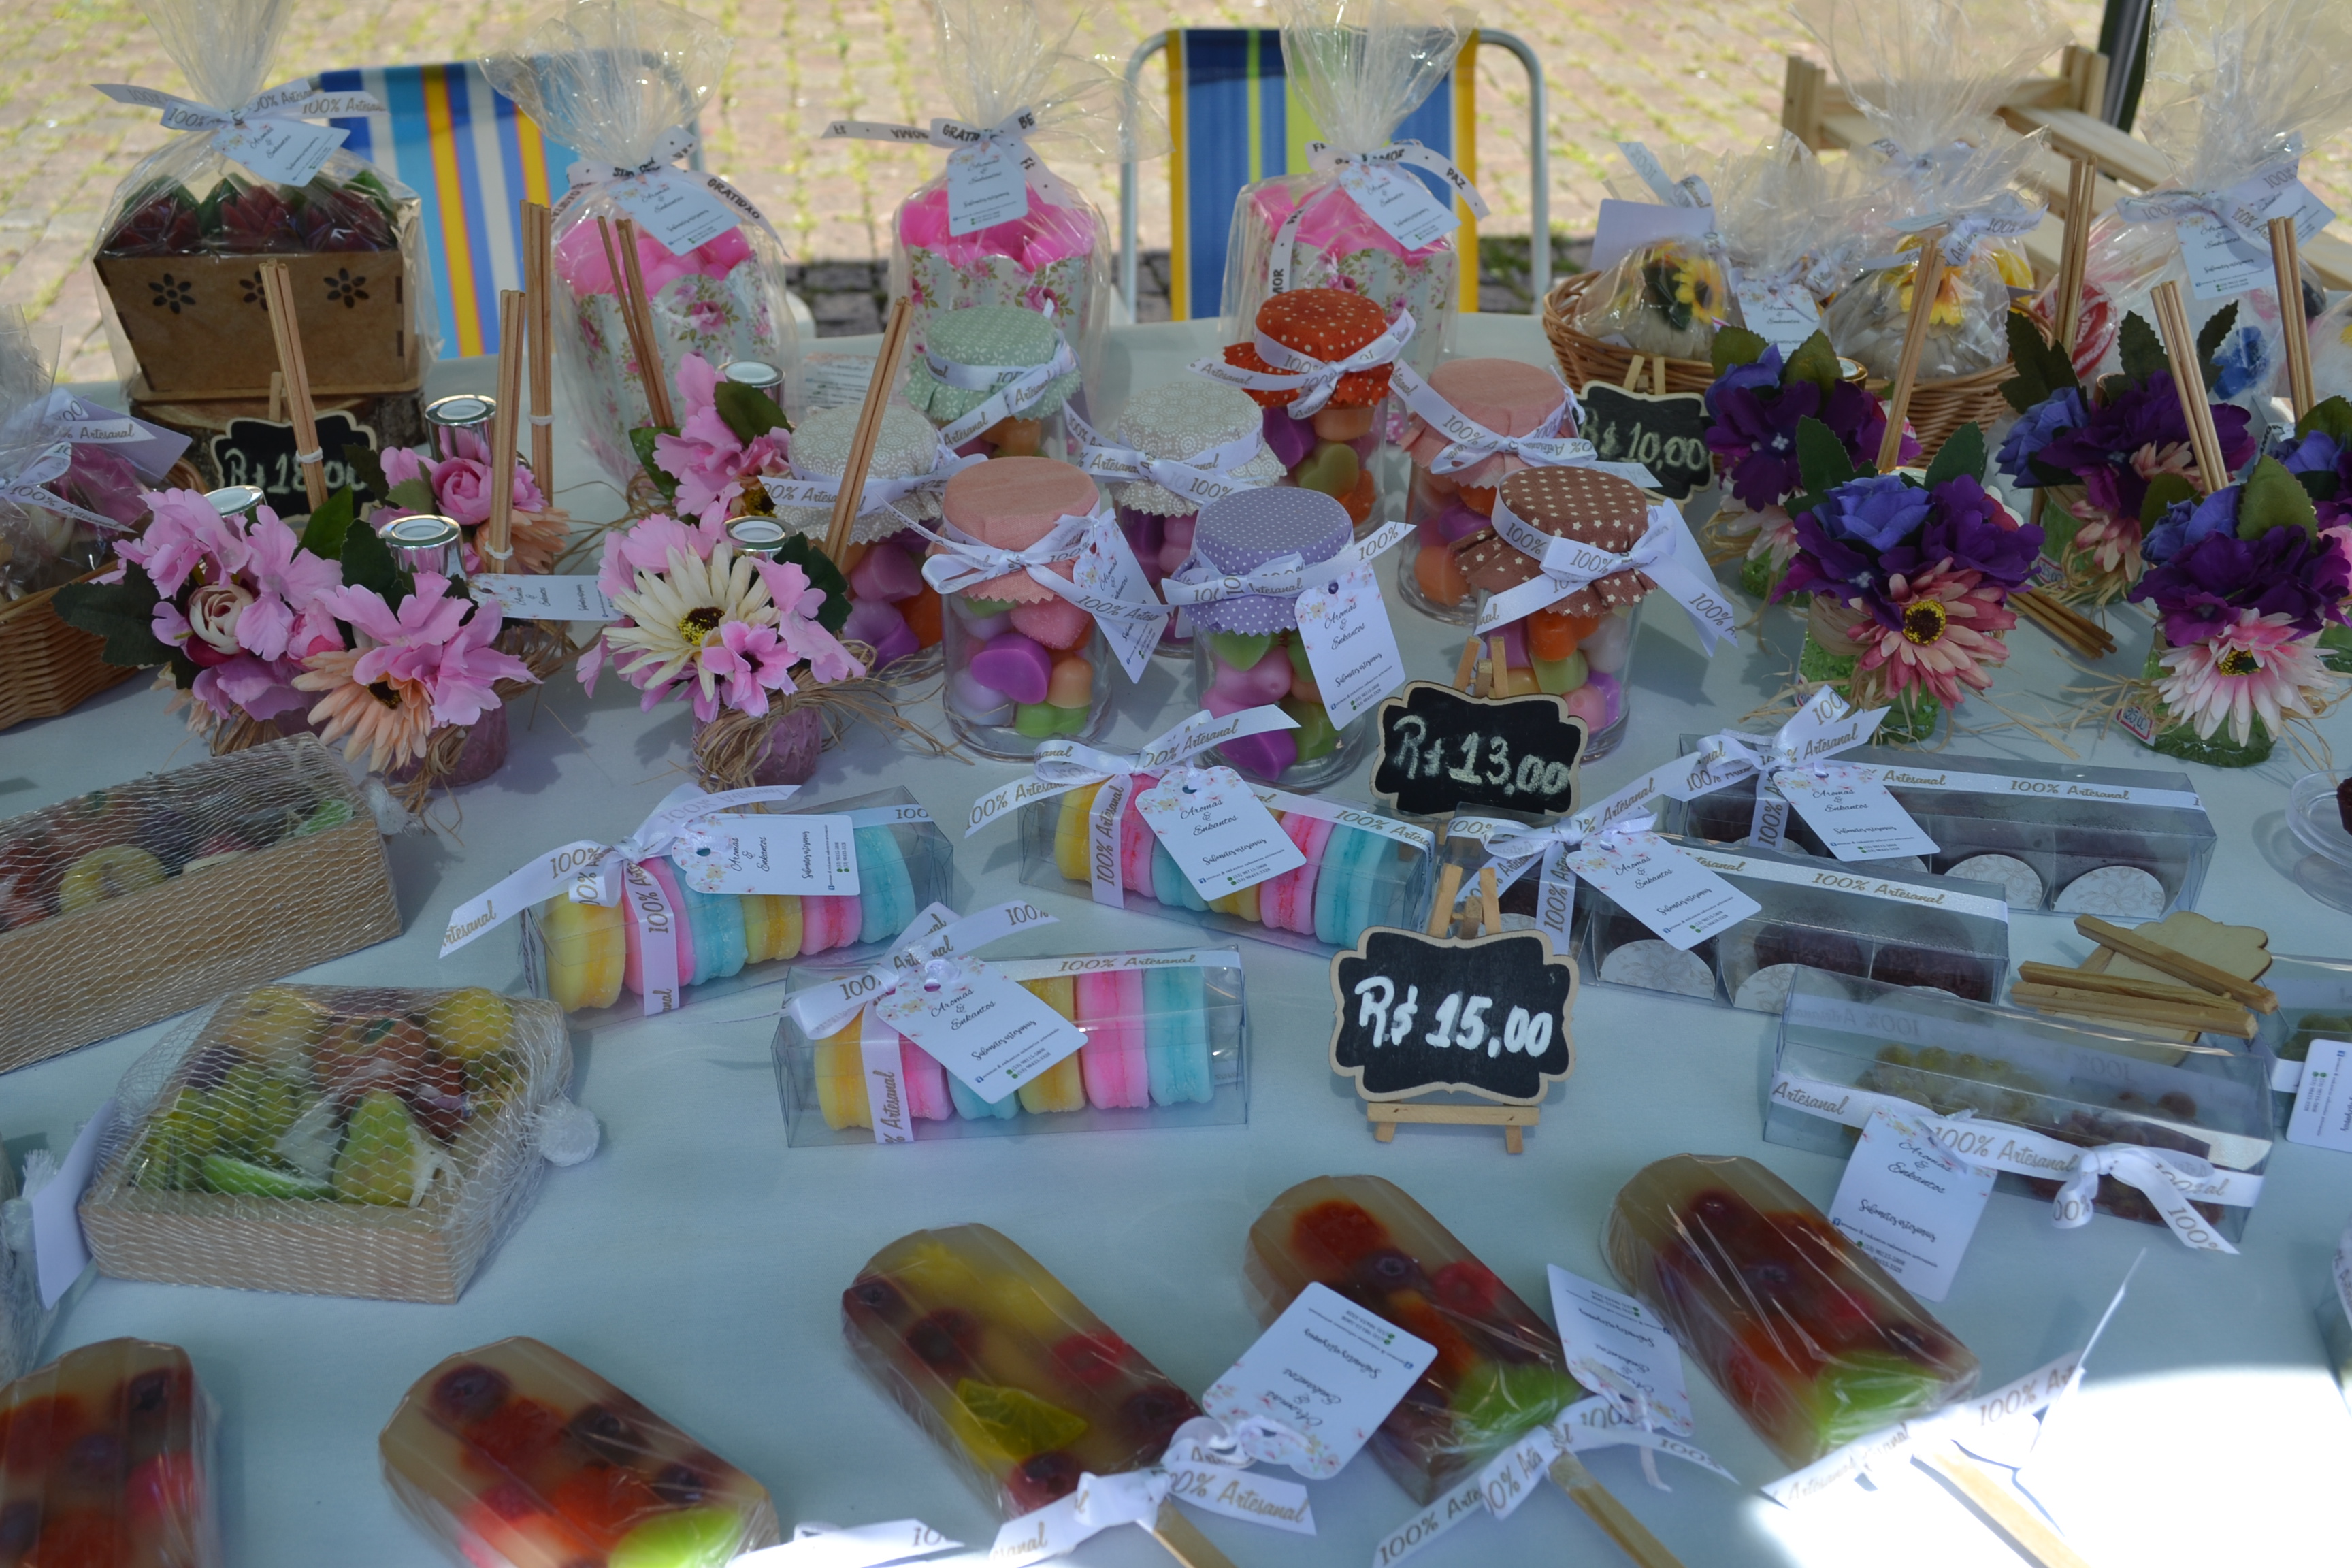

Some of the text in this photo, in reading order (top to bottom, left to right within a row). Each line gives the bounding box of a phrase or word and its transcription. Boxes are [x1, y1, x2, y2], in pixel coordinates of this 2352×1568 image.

[1446, 167, 1466, 190] PAZ
[1015, 370, 1051, 406] Artesanal
[1200, 362, 1254, 385] Artesanal
[80, 423, 134, 440] Artesanal
[944, 411, 989, 445] Artesanal
[1441, 414, 1486, 446] 100%
[1621, 422, 1710, 471] 10,00
[10, 485, 60, 507] 100%
[1358, 525, 1400, 562] 100%
[1506, 522, 1548, 555] 100%
[1569, 549, 1614, 575] 100%
[1075, 595, 1126, 616] 100%
[1324, 602, 1357, 630] Aromas
[1688, 593, 1733, 627] 100%
[1331, 622, 1366, 650] Enkantos
[1181, 718, 1239, 754] Artesanal
[1803, 723, 1858, 760] Artesanal
[1448, 732, 1571, 796] 13,00
[1601, 777, 1656, 826] Artesanal
[1812, 789, 1855, 798] Aromas
[1882, 770, 2131, 802] Artesanal 100% Artesanal
[1179, 799, 1224, 819] Aromas
[1202, 811, 1212, 821] &
[1333, 808, 1386, 834] 100%
[1825, 802, 1869, 813] Enkantos
[1095, 785, 1124, 887] 100% Artesanal
[1192, 815, 1239, 836] Enkantos
[1759, 803, 1783, 849] 100%
[549, 846, 601, 880] 100%
[728, 837, 742, 872] Aromas
[755, 836, 770, 872] Enkantos
[1614, 855, 1652, 877] Aromas
[1635, 868, 1673, 889] Enkantos
[1812, 872, 1946, 906] 100% Artesanal
[641, 891, 669, 934] 100%
[1544, 883, 1568, 934] 100%
[1059, 953, 1196, 973] 100% Artesanal
[930, 988, 974, 1018] Aromas
[950, 1000, 996, 1031] Enkantos
[956, 1003, 967, 1014] &
[1354, 975, 1553, 1059] R$ 15,00
[879, 1070, 904, 1130] Artesanal
[1772, 1081, 1850, 1115] Artesanal
[1997, 1139, 2078, 1174] Artesanal
[1899, 1142, 1953, 1173] Aromas
[1887, 1162, 1946, 1194] Enkantos
[1217, 1482, 1309, 1525] Artesanal
[1379, 1513, 1439, 1566] 100%
